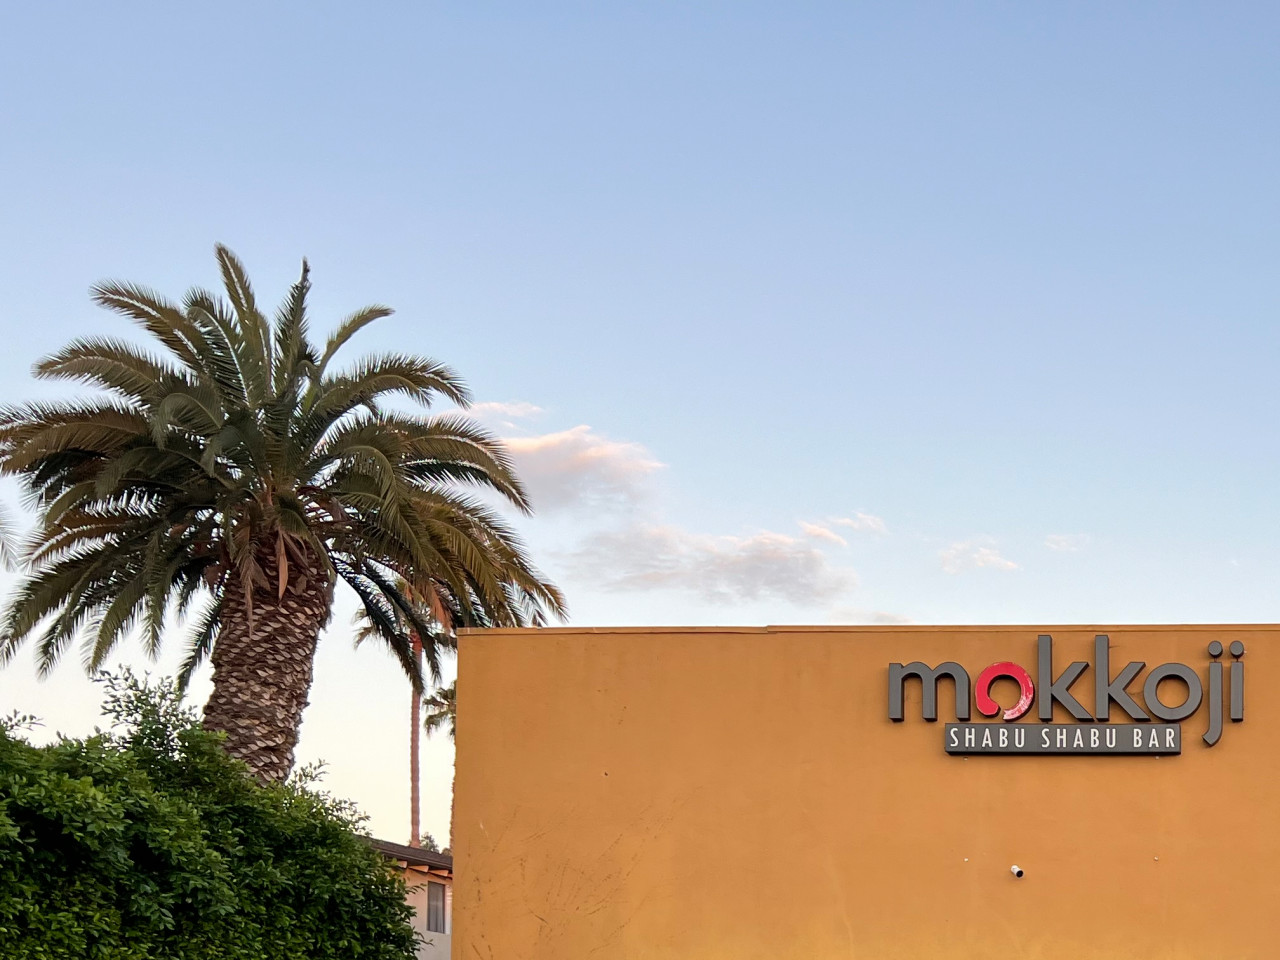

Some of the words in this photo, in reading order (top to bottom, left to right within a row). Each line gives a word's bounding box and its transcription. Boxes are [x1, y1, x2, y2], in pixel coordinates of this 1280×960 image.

[888, 634, 1244, 746] mokkoji
[949, 728, 1025, 748] SHABU
[1041, 728, 1117, 748] SHABU
[1133, 728, 1176, 748] BAR
